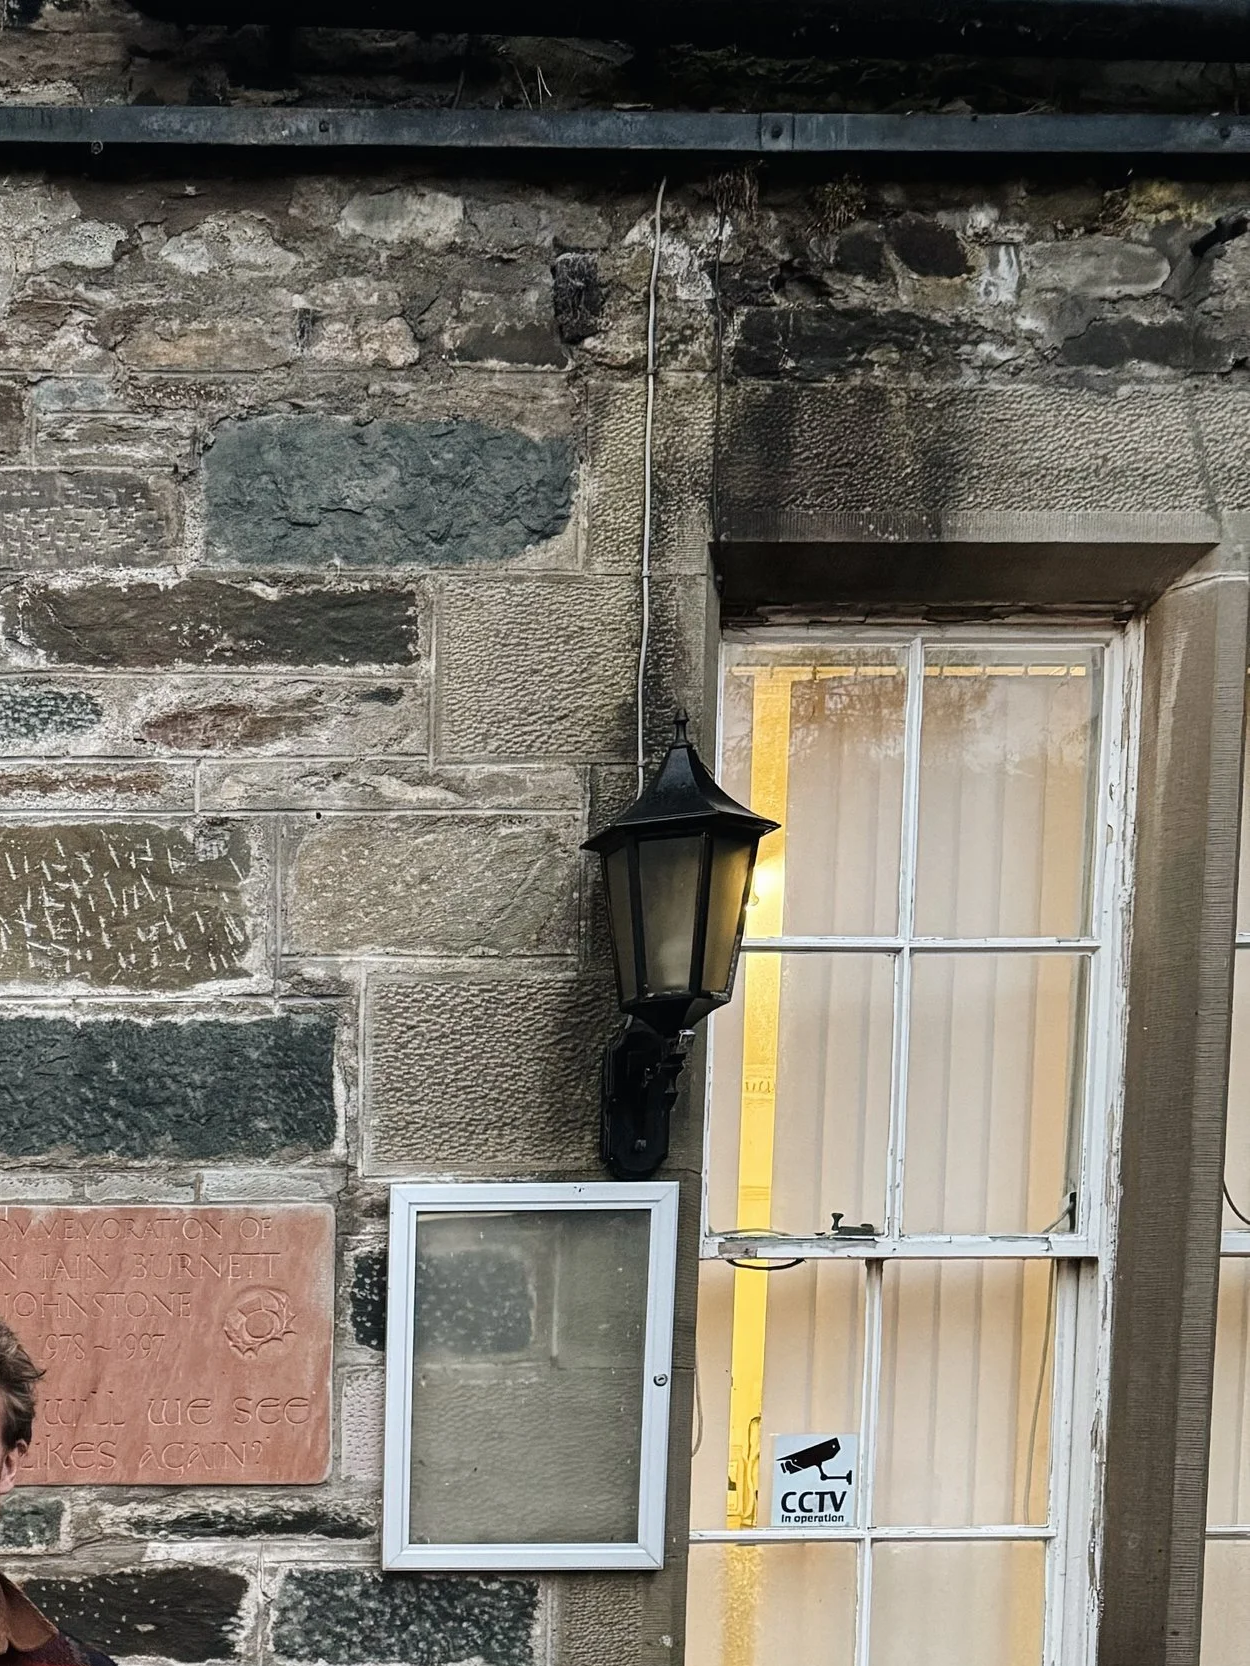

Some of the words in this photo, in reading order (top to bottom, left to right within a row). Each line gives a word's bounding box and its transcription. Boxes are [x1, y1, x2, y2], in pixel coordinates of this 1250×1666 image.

[239, 1216, 272, 1241] OF
[41, 1253, 111, 1281] IAIN
[132, 1252, 282, 1281] BURNETT
[3, 1290, 192, 1320] JOHNSTONE
[37, 1332, 87, 1362] 1978
[116, 1332, 167, 1362] 1997
[780, 1490, 848, 1514] CCTV
[793, 1513, 845, 1525] operation
